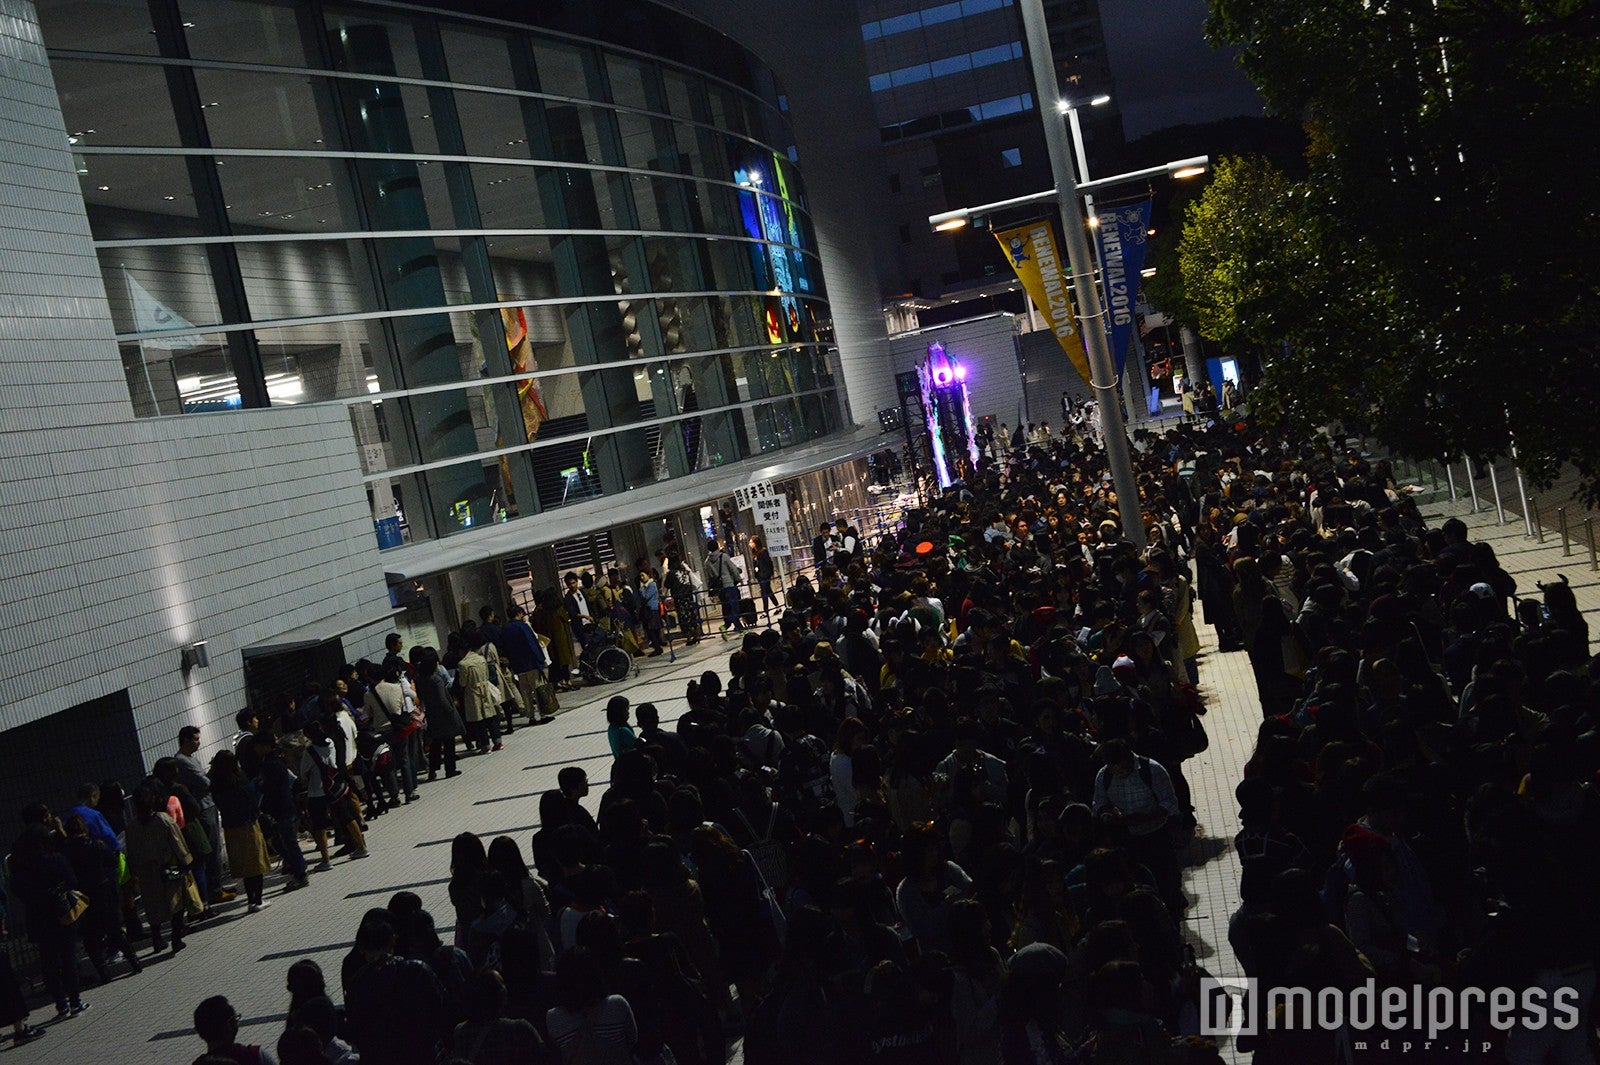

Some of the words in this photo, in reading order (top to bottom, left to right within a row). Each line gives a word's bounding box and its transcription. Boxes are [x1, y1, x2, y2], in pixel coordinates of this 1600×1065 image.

[1030, 225, 1074, 338] RENEWAL2016
[757, 499, 781, 509] 関係者
[764, 511, 779, 521] 受付
